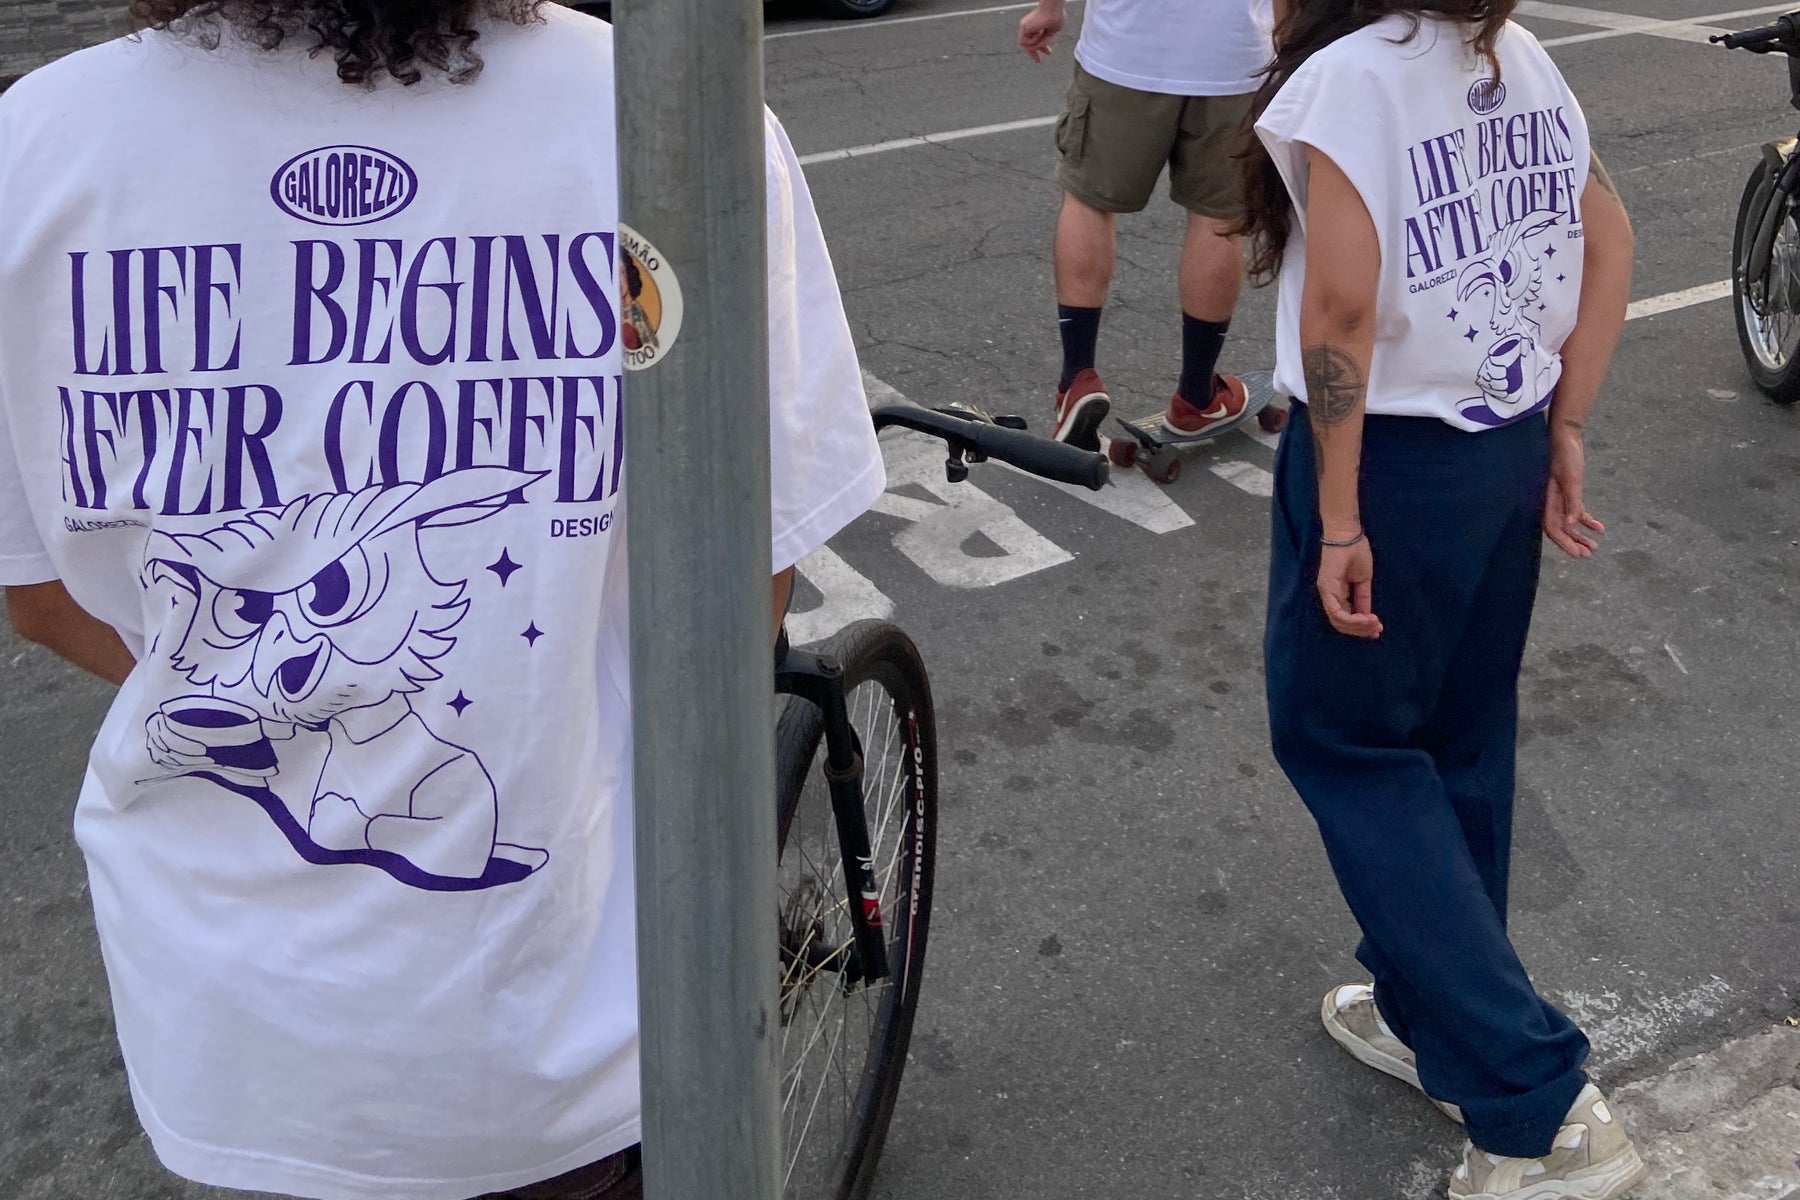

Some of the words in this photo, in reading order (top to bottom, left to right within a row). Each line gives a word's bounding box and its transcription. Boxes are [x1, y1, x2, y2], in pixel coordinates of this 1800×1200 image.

[1476, 106, 1573, 180] BEGINS
[285, 152, 404, 218] GALOREZZI
[1490, 167, 1581, 232] COFFE
[67, 243, 242, 376] LIFE
[286, 232, 617, 367] BEGINS
[1408, 268, 1458, 294] GALOREZZI
[57, 384, 289, 516] AFTER
[323, 375, 623, 504] COFFE
